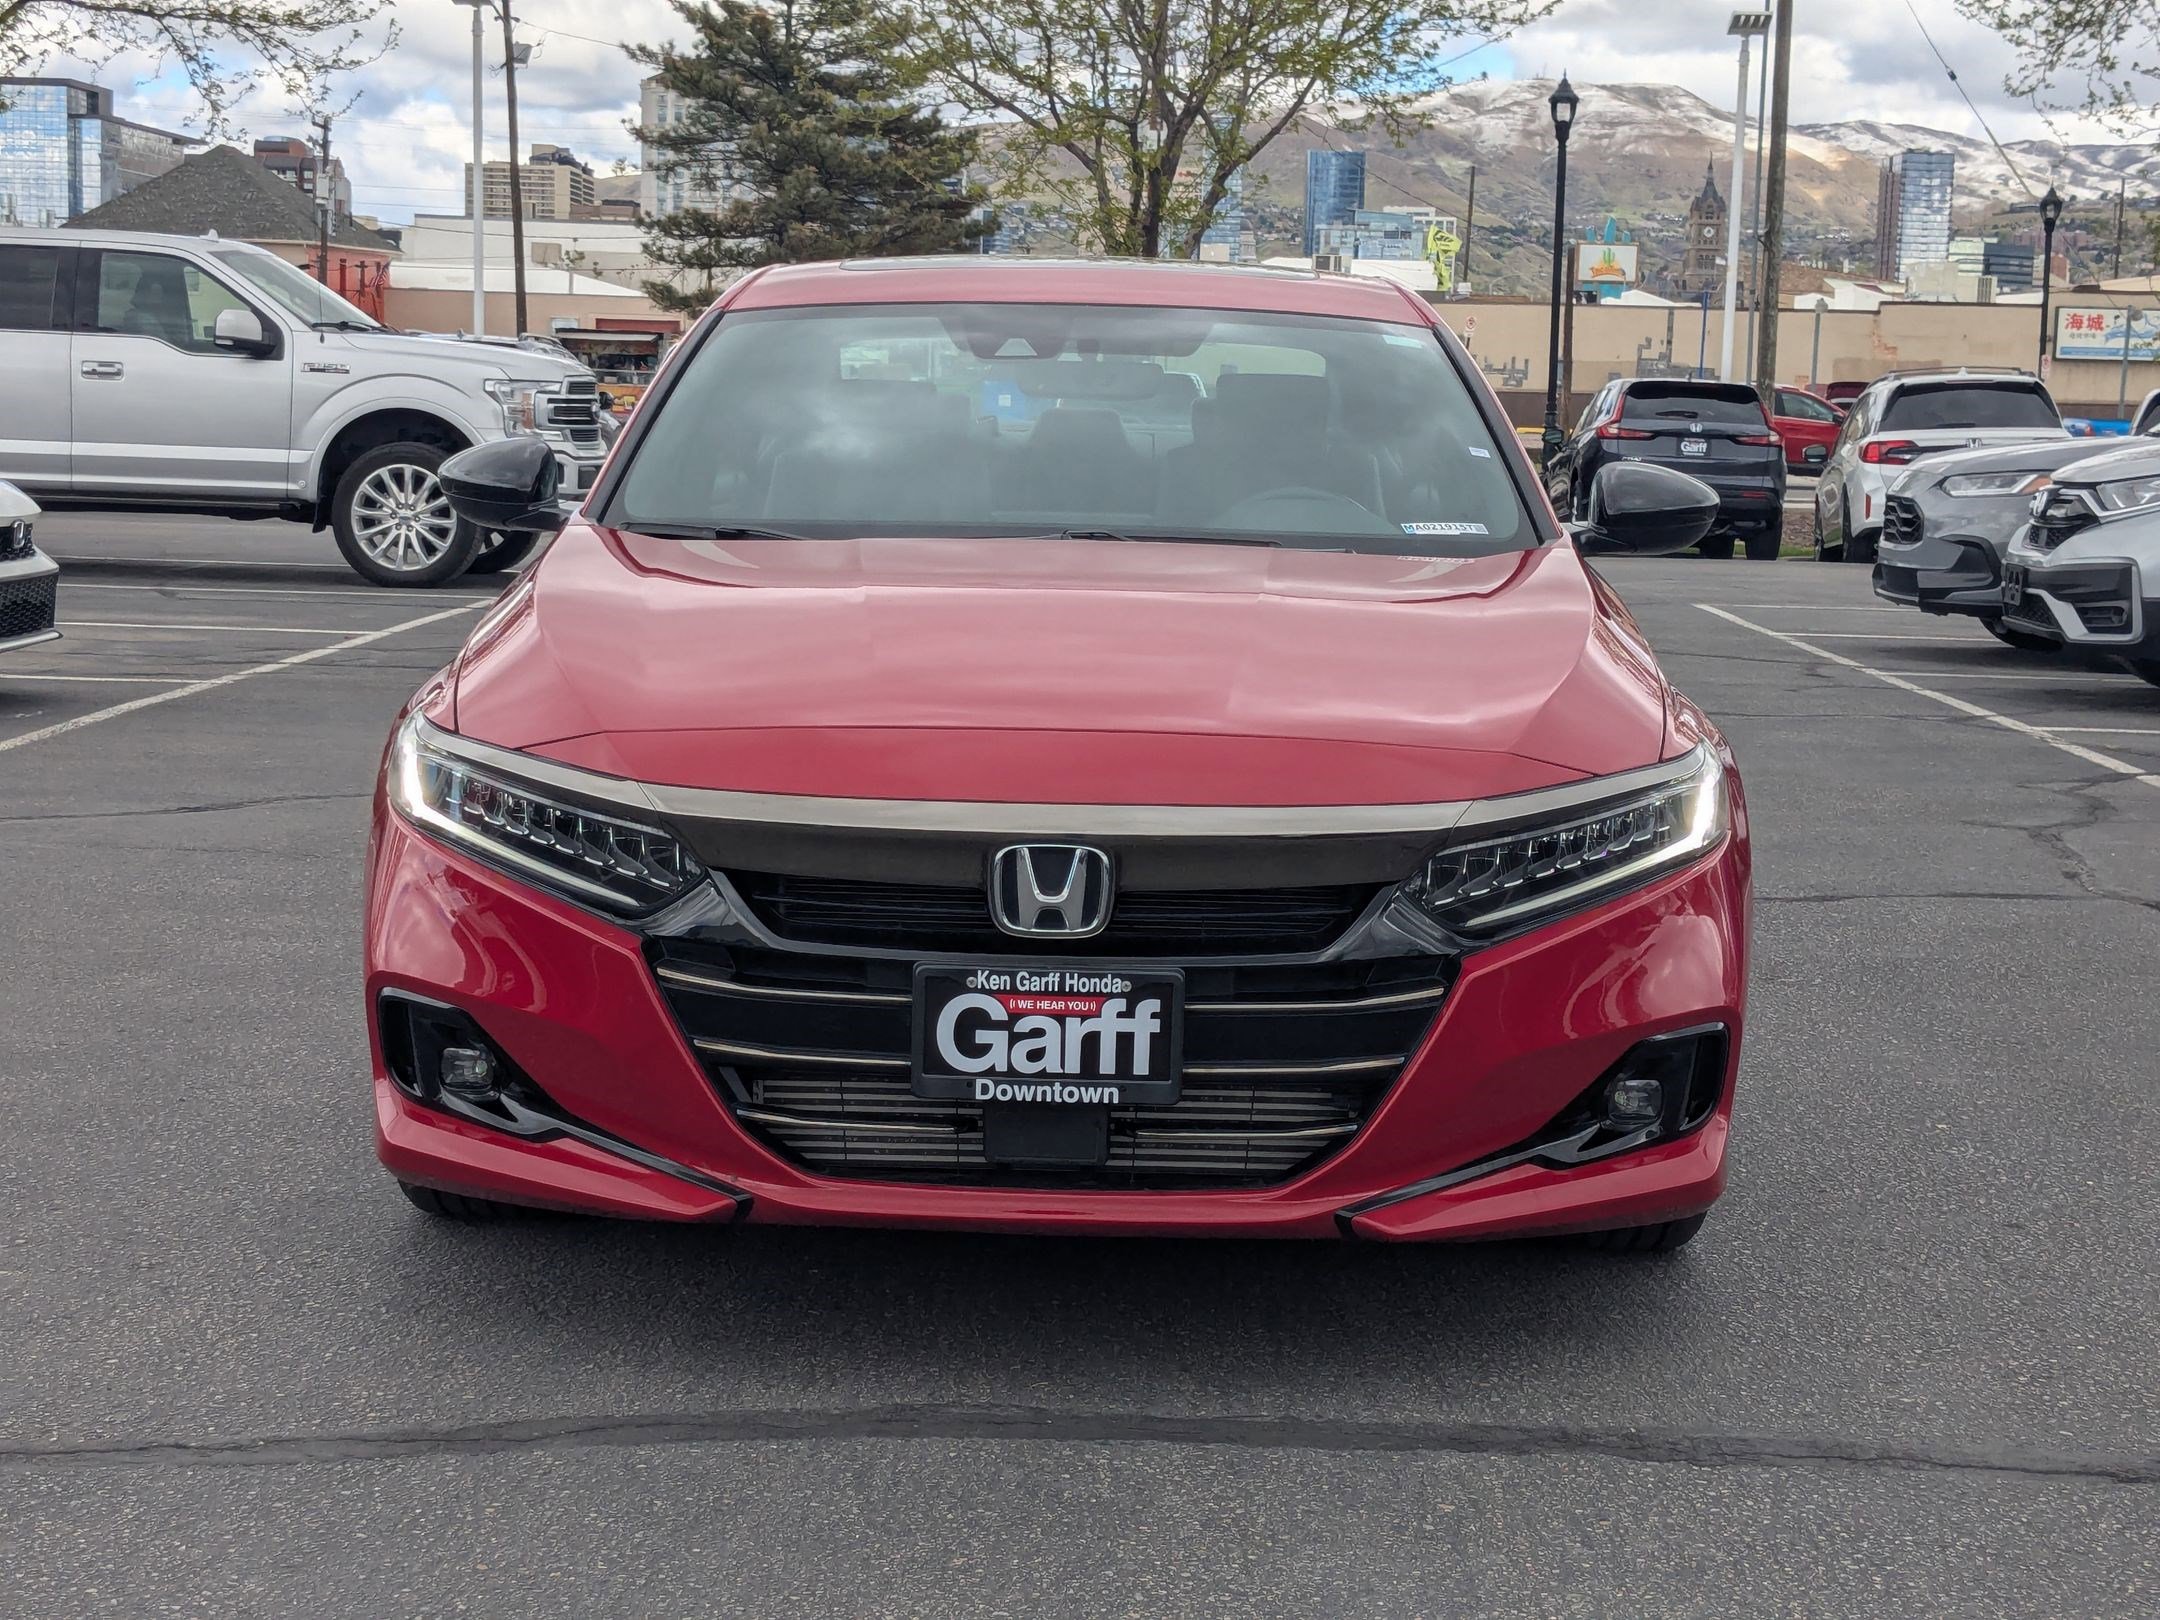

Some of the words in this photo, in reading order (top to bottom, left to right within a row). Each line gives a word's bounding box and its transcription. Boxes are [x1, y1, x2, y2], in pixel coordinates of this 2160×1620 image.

[2064, 312, 2105, 332] 海城
[1680, 441, 1708, 453] Garff
[977, 970, 1011, 990] Ken
[1016, 971, 1060, 992] Garff
[1065, 973, 1122, 993] Honda
[1037, 1000, 1065, 1010] HEAR
[936, 993, 1161, 1075] Garff
[975, 1079, 1119, 1104] Downtown
